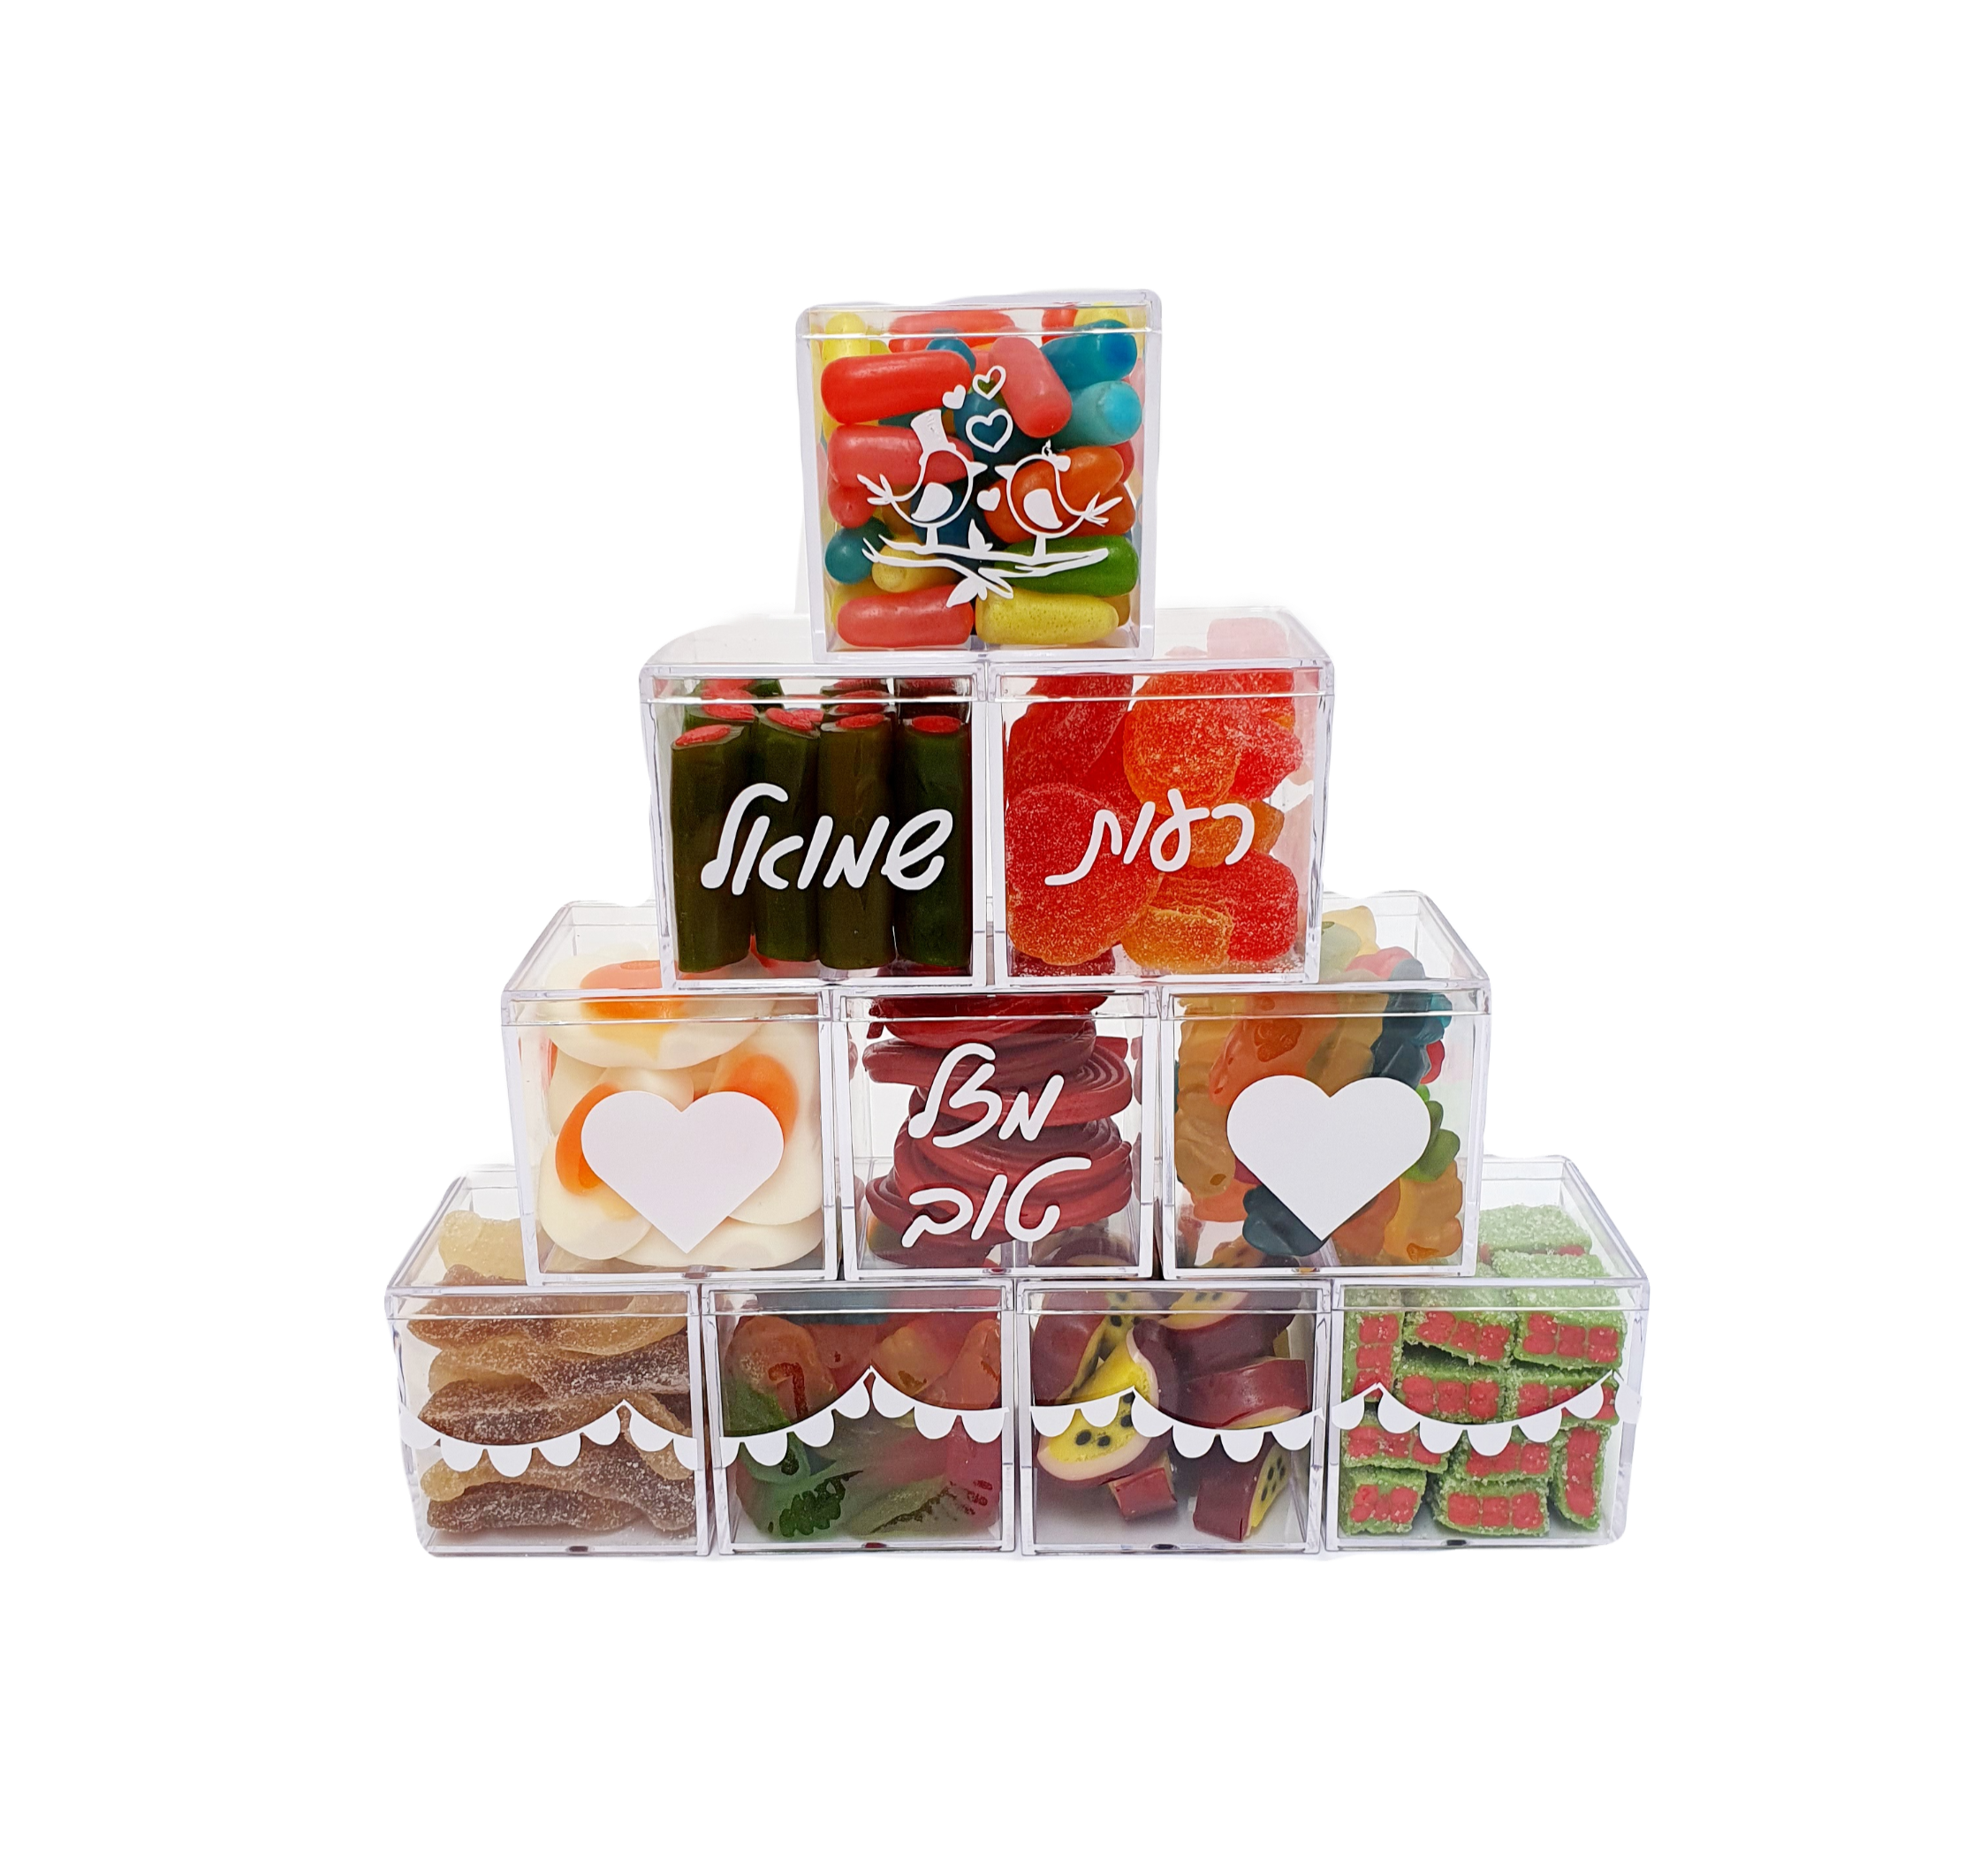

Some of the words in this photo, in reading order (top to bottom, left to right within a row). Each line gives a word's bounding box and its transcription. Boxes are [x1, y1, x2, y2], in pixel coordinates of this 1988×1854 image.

[701, 783, 953, 896] שמואל
[1044, 788, 1255, 886] רעות
[907, 1042, 1065, 1149] מזל
[901, 1156, 1092, 1248] טוב
